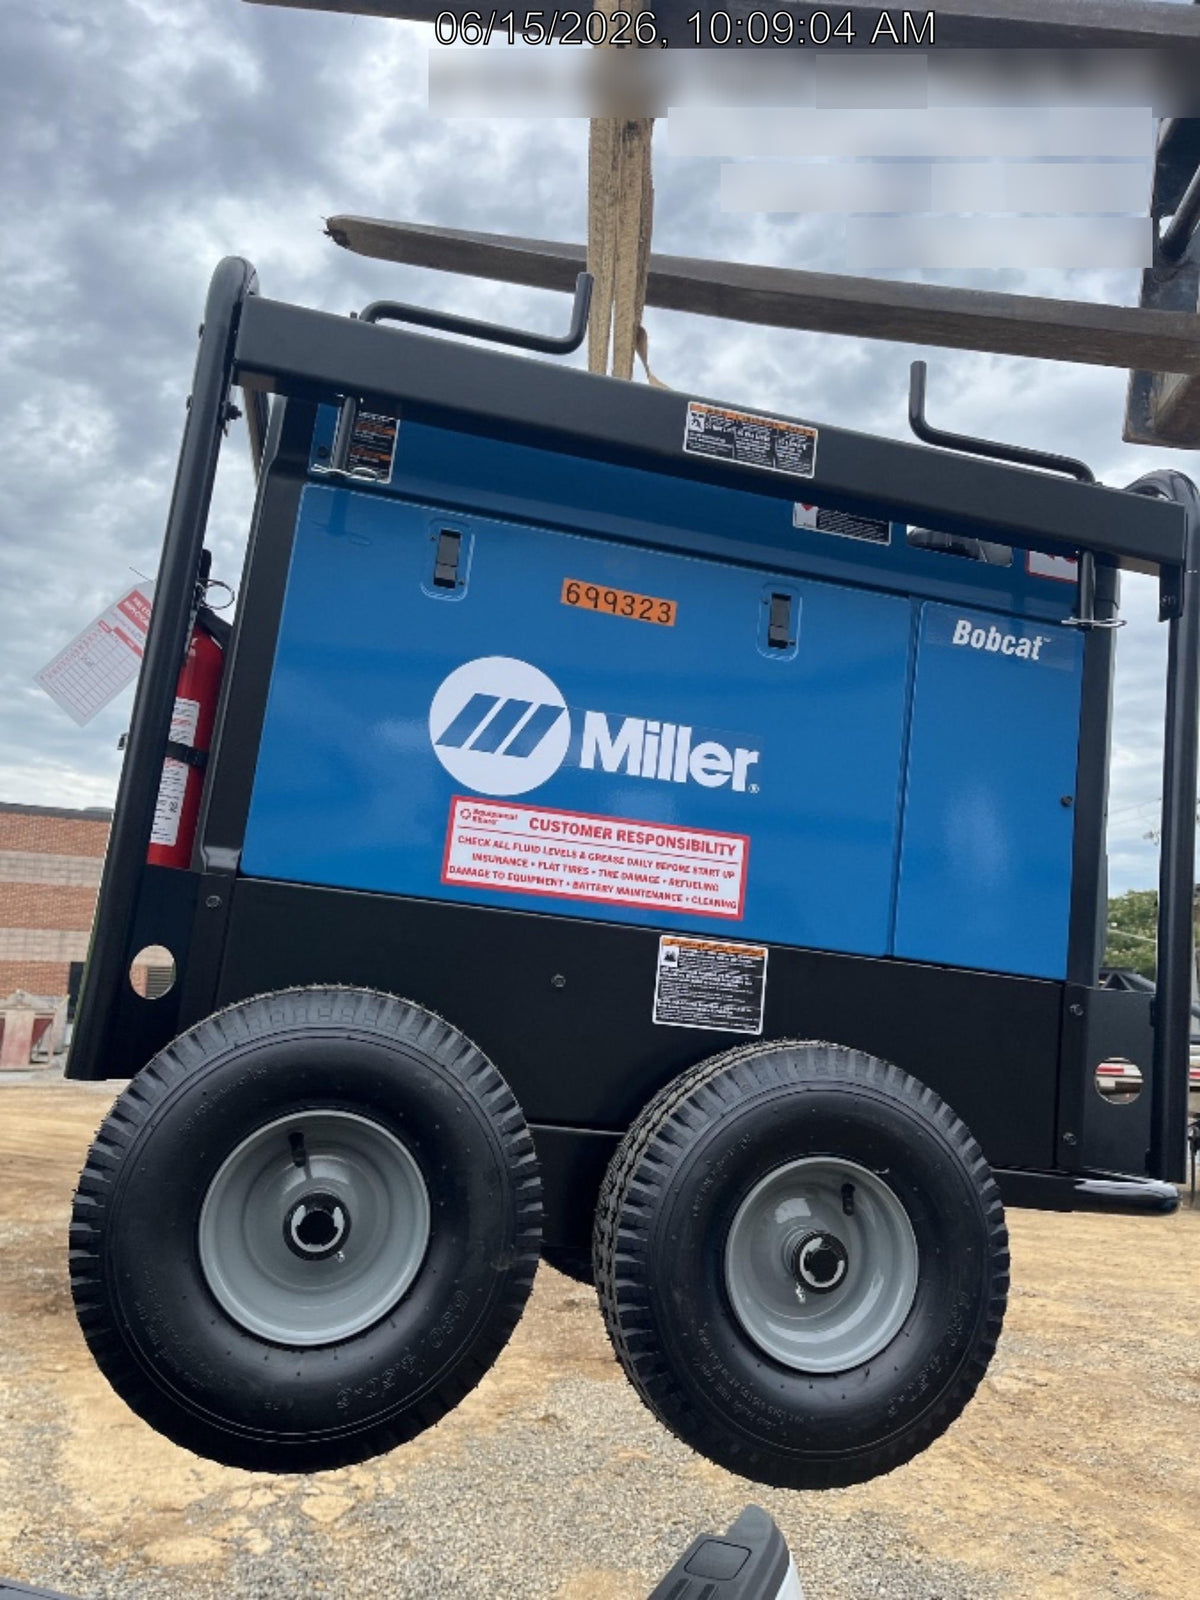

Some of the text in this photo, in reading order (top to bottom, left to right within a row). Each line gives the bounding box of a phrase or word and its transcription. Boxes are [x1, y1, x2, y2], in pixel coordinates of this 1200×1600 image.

[565, 583, 672, 624] 699323
[952, 619, 1043, 661] Bobcat
[579, 710, 759, 792] Miller
[458, 835, 491, 847] CHECK
[493, 840, 510, 850] ALL
[513, 842, 541, 854] FLUID
[543, 846, 576, 859] LEVELS
[588, 852, 625, 865] GREASE
[627, 858, 653, 868] DAILY
[656, 861, 690, 874] BEFORE
[692, 867, 720, 878] START
[723, 870, 735, 879] UP
[529, 817, 737, 857] CUSTOMER RESPONSIBILITY
[449, 865, 737, 909] DAMAGE TO EQUIPMENT BATTERY MAINTENANCE CLEANING
[472, 853, 528, 868] INSURANCE
[563, 864, 589, 875] TIRES
[598, 868, 619, 879] TIRE
[621, 871, 660, 884] DAMAGE
[668, 877, 719, 892] REFUELING
